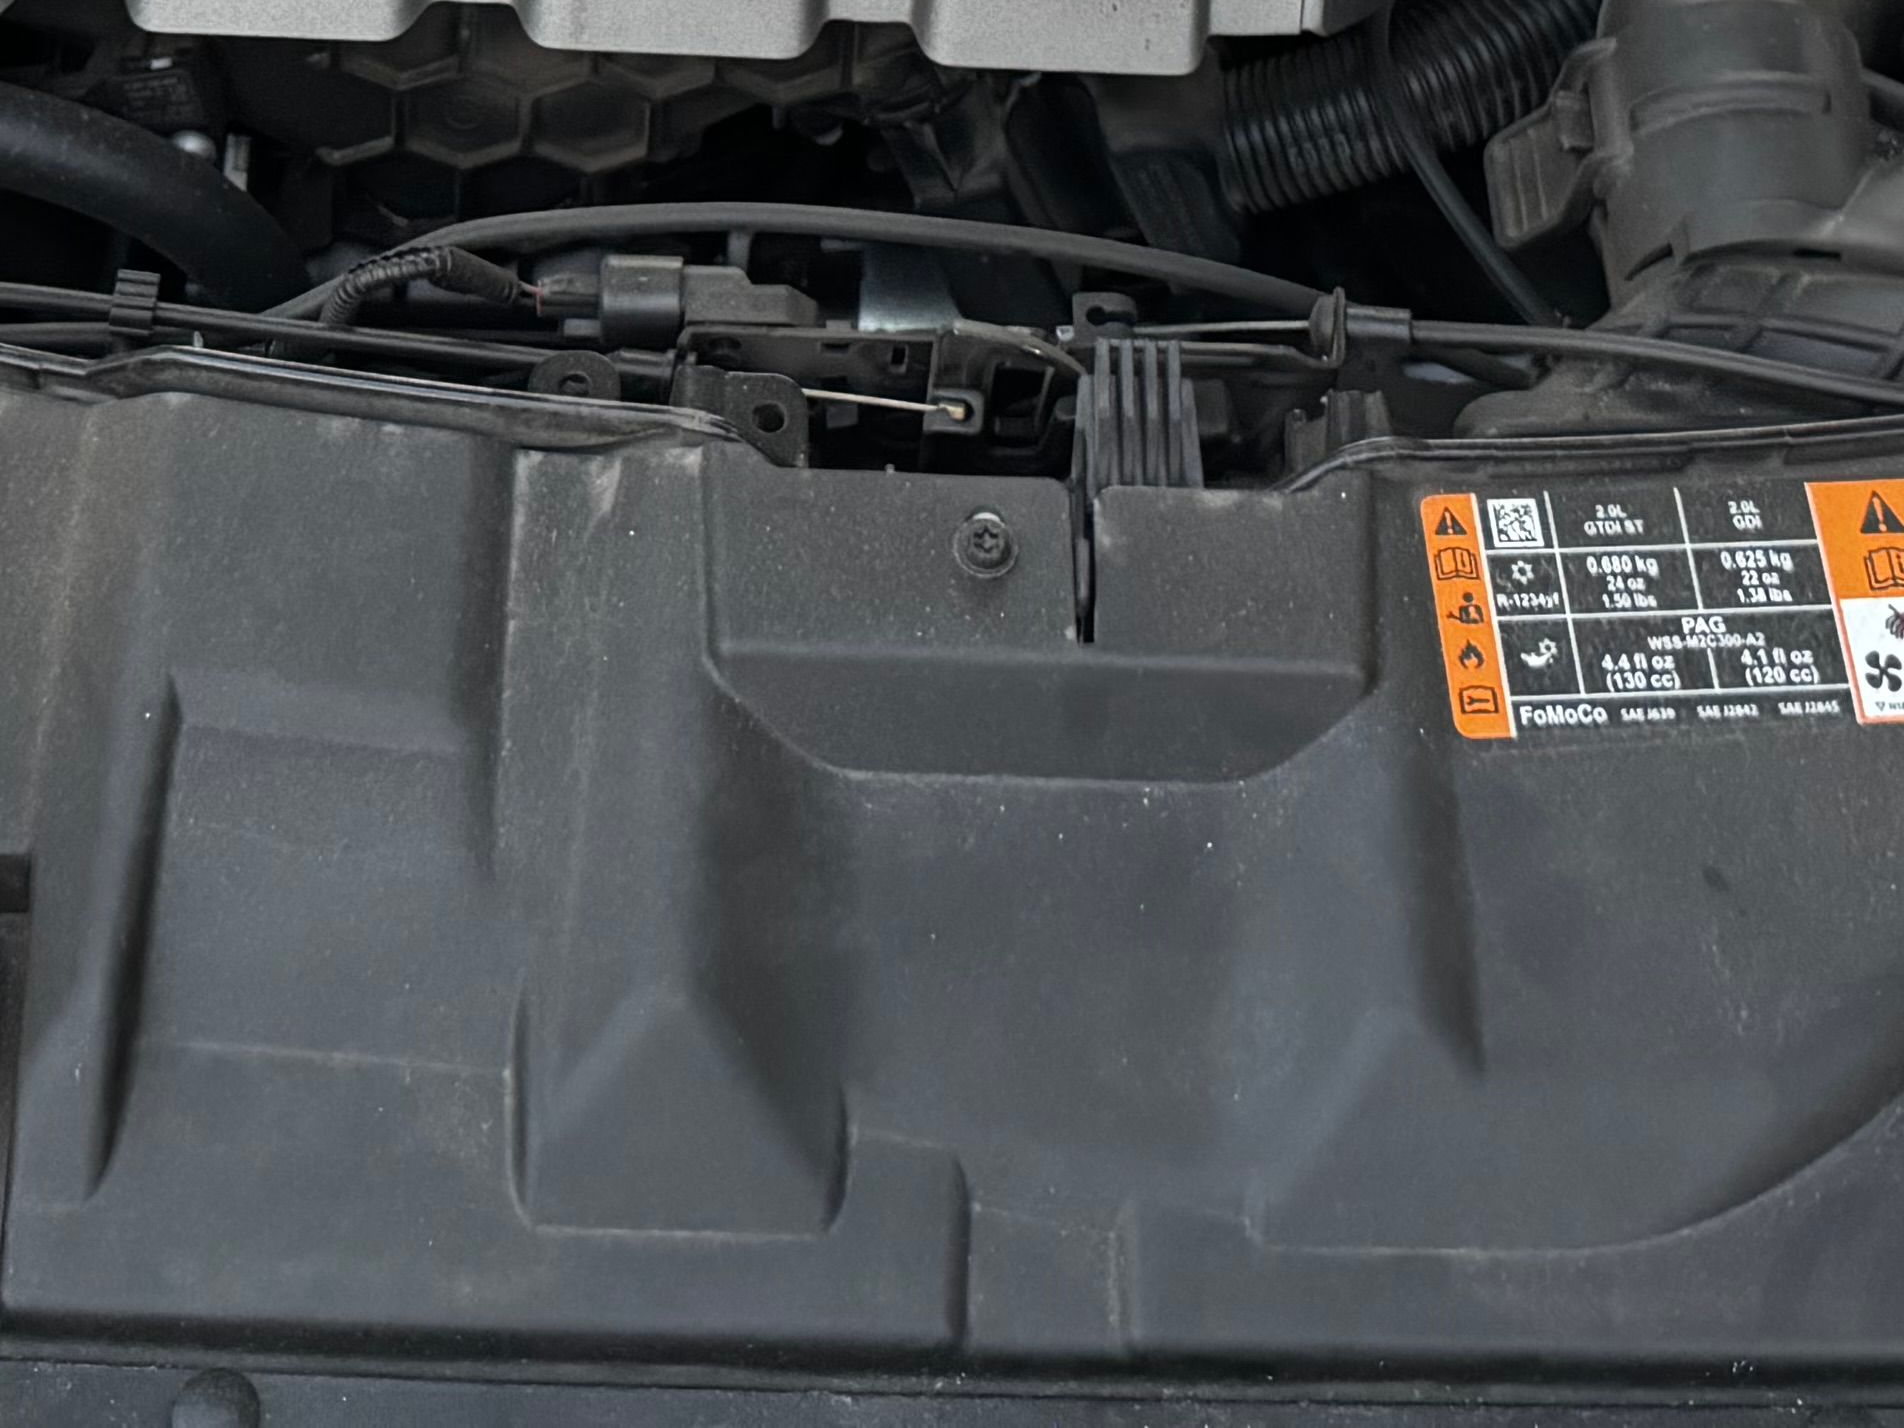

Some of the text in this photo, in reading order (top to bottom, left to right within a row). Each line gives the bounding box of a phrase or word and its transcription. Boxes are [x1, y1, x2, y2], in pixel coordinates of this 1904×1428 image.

[1595, 504, 1628, 519] 2.0L
[1727, 499, 1760, 514] 2.0L
[1583, 519, 1645, 537] GTDI ST
[1732, 514, 1764, 532] GDI
[1586, 555, 1660, 580] 0.680 kg
[1720, 549, 1795, 574] 0.625 kg
[1606, 576, 1647, 592] 24 oz
[1741, 570, 1781, 586] 22 oz
[1496, 592, 1560, 612] R-1234yf
[1633, 593, 1658, 608] lbs
[1768, 587, 1794, 603] lbs
[1681, 616, 1727, 635] PAG
[1647, 631, 1766, 651] WSS-M2C300-A2
[1601, 652, 1676, 672] 4.4 fl oz
[1740, 647, 1815, 666] 4.1 fl oz
[1605, 669, 1682, 693] (130 cc)
[1745, 664, 1821, 687] (120 cc)
[1519, 703, 1609, 728] FoMoCo
[1620, 707, 1645, 722] SAE
[1696, 704, 1722, 720] SAE
[1777, 701, 1803, 716] SAE
